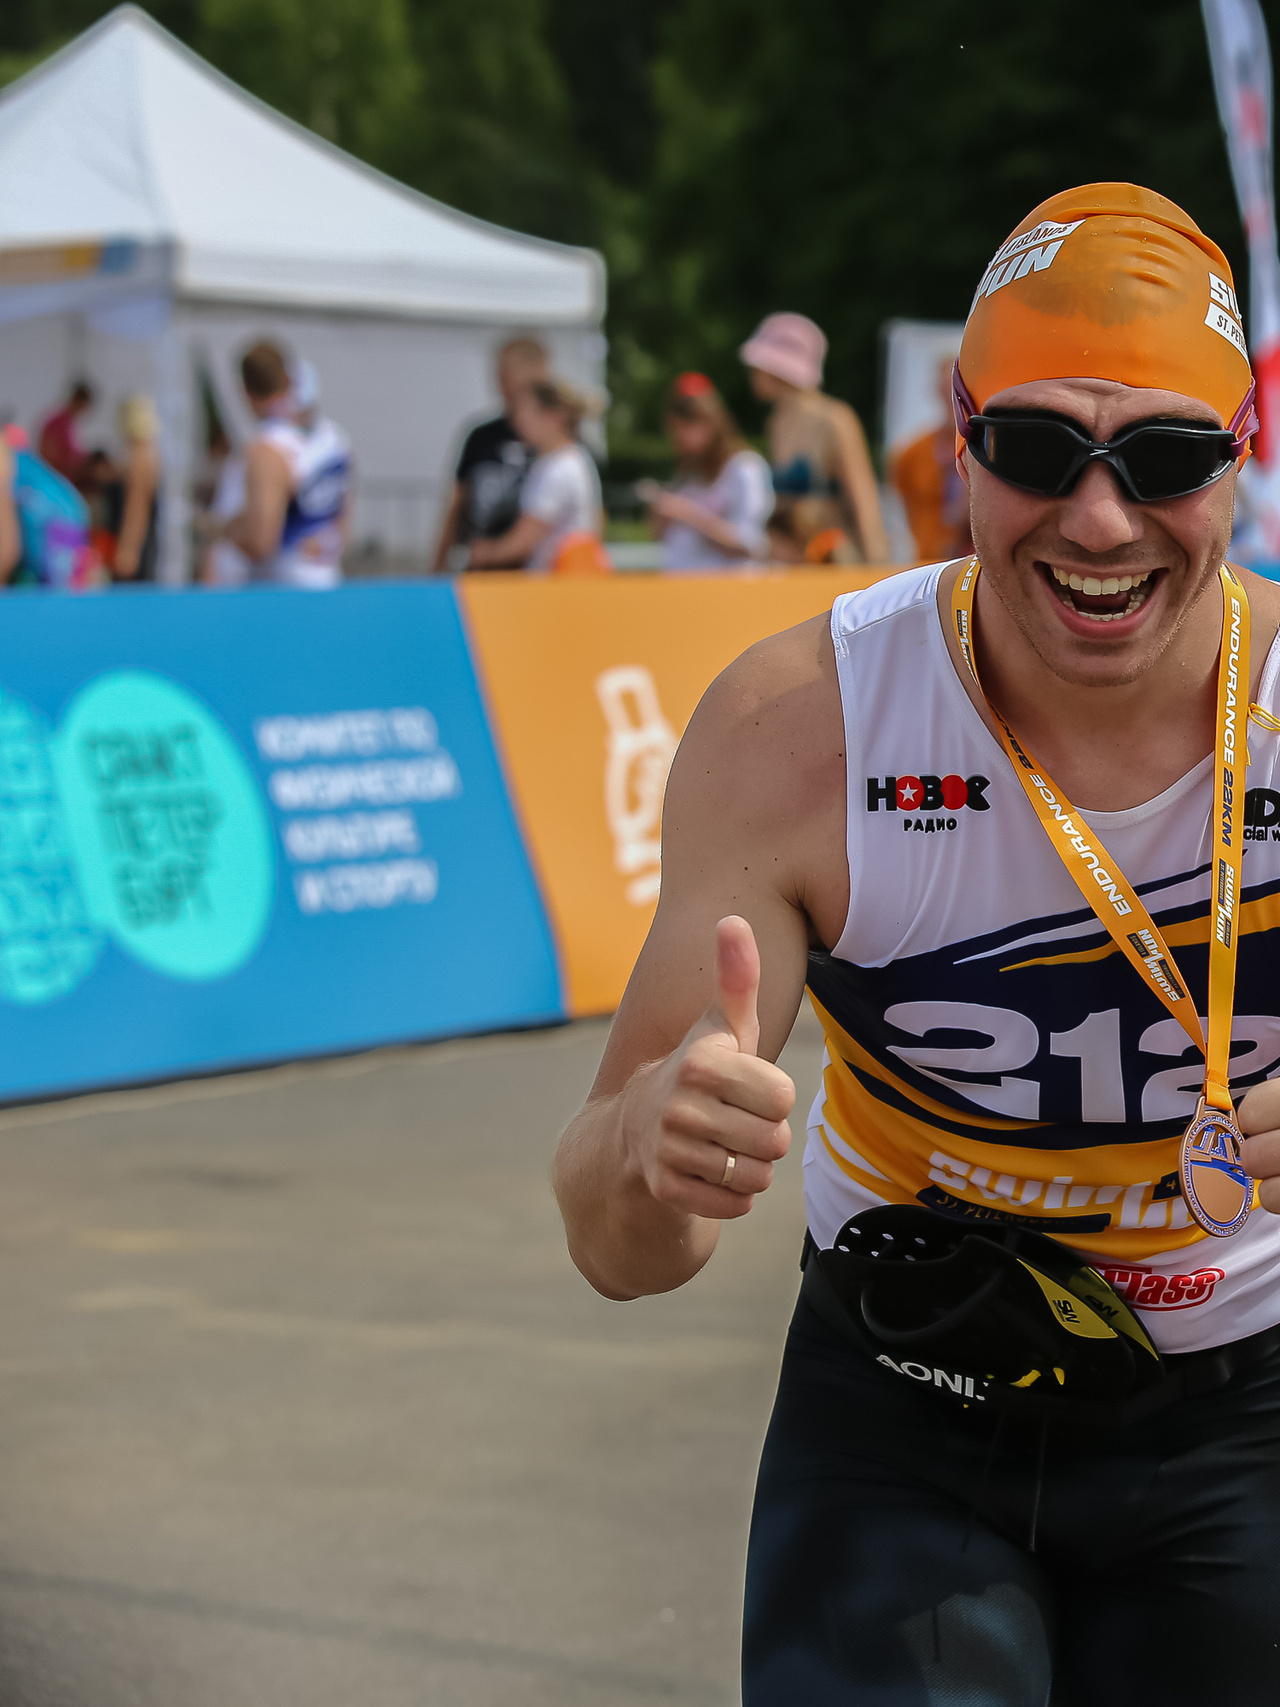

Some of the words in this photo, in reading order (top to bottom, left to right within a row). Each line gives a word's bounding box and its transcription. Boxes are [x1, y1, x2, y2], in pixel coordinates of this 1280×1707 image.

[1222, 595, 1241, 766] ENDURANCE
[903, 817, 958, 833] РАДИО
[1029, 774, 1133, 917] ENDURANCE
[1220, 766, 1235, 847] 22KM
